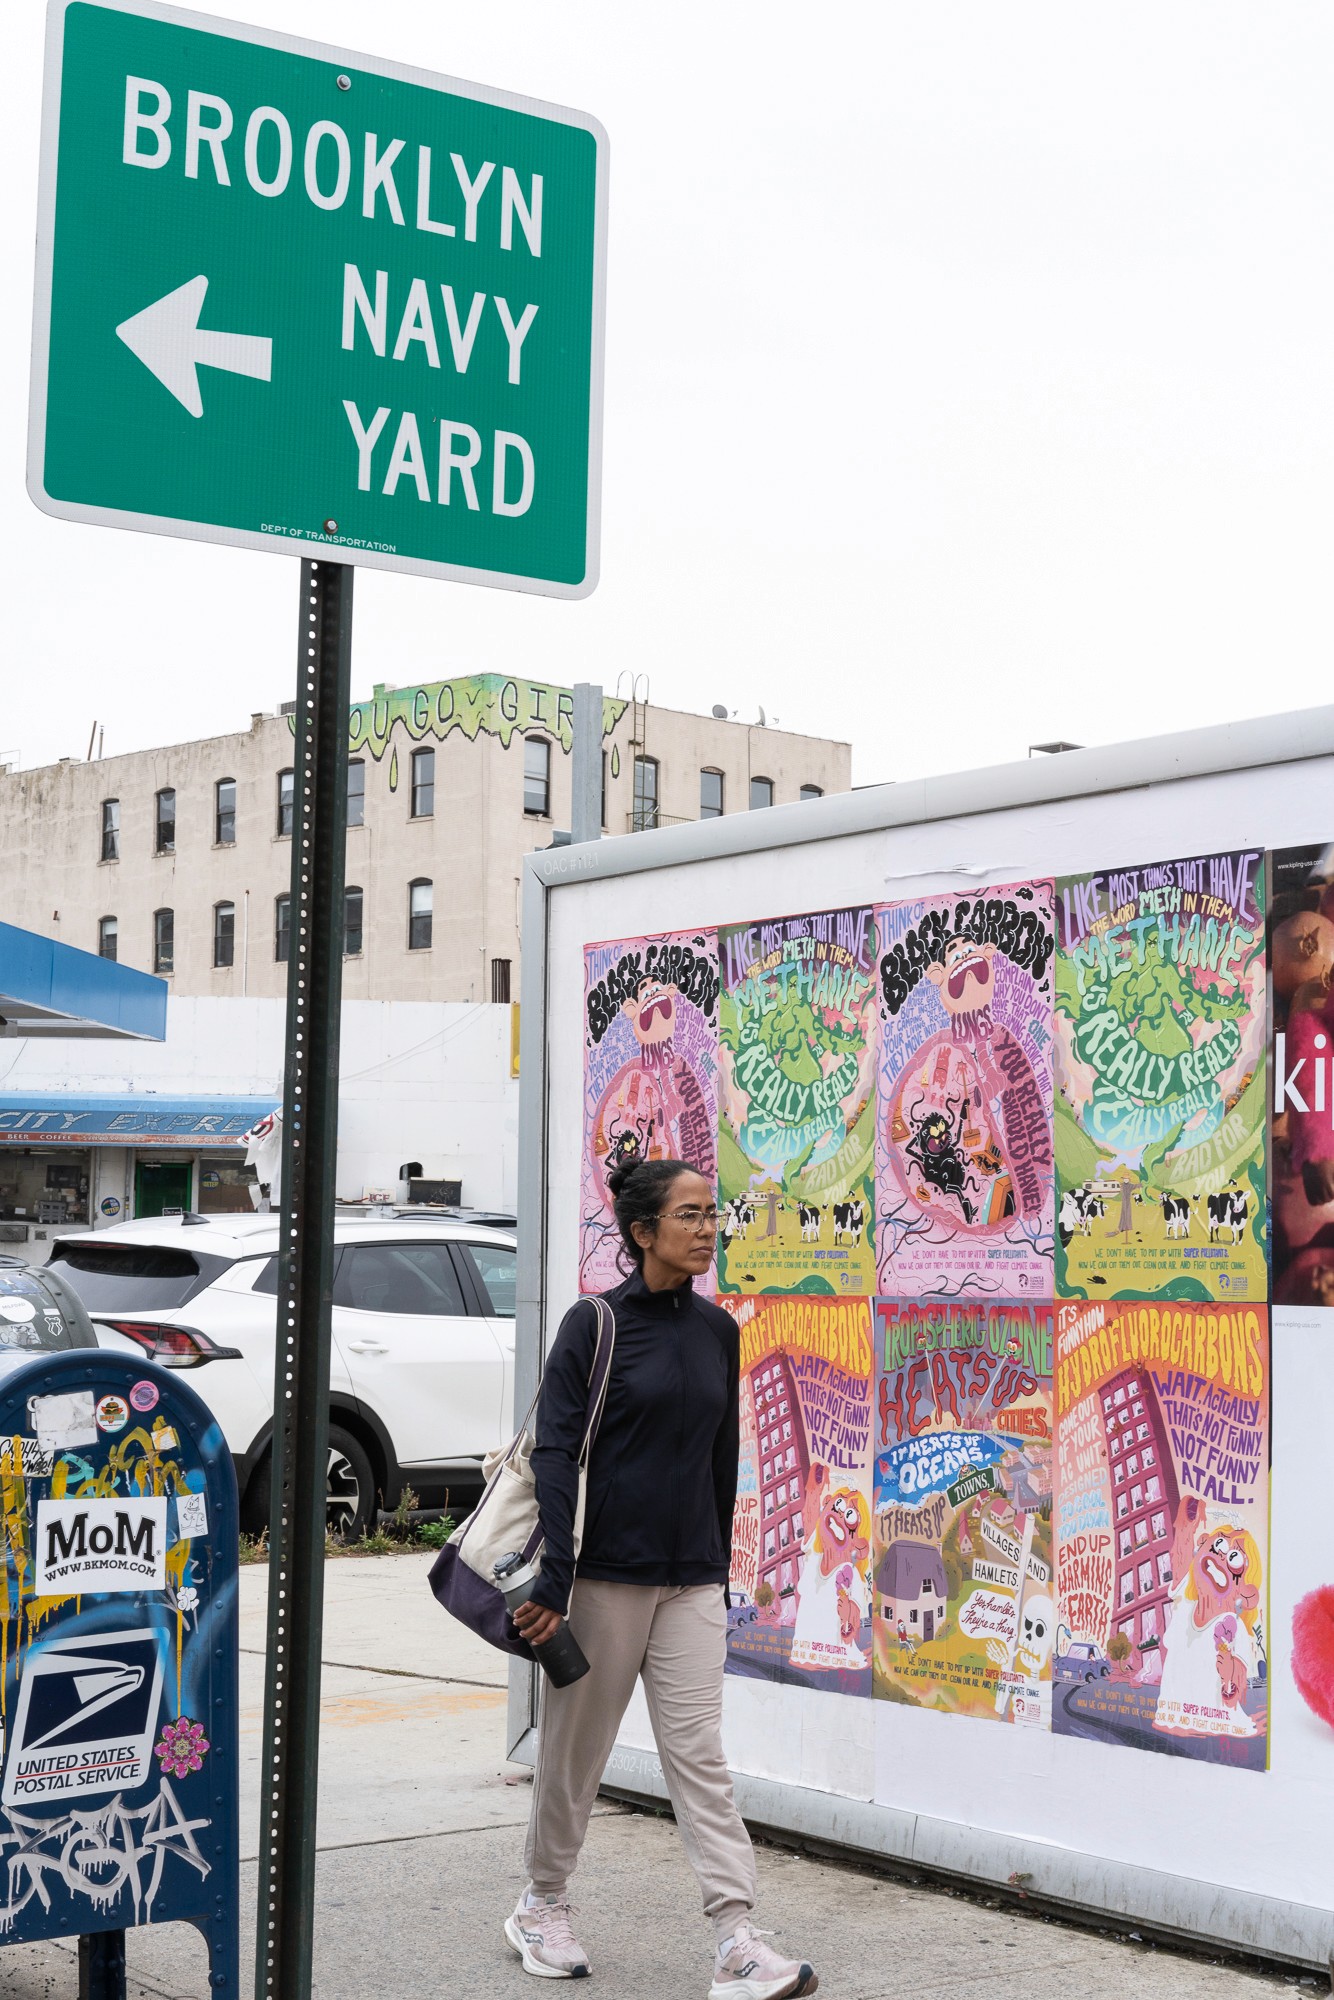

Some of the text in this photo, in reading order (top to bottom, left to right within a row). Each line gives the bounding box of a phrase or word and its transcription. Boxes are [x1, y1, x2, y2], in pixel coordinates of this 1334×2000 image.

[122, 74, 544, 258] BROOKLYN
[342, 262, 540, 385] NAVY
[342, 400, 536, 518] YARD
[261, 524, 396, 552] DEPT OF TRANSPORTATION
[349, 681, 574, 740] OU GO GIR
[1063, 853, 1259, 951] LIKE MOST THINGS THAT HAVE
[1090, 916, 1110, 935] THE
[1110, 903, 1136, 925] WORD
[1183, 893, 1196, 913] IN
[878, 902, 925, 949] THINK OF
[586, 949, 612, 985] THINK
[727, 909, 873, 992] LIKE MOST THINGS THAT HAVE
[762, 943, 827, 969] WORD IN
[880, 899, 1054, 1015] BLACK CARBON
[992, 954, 1008, 969] AND
[1072, 914, 1254, 996] METHANE
[587, 945, 720, 1043] BLACK CARBON
[734, 960, 868, 1031] METHANE
[993, 984, 1024, 1005] WHY YOU
[995, 966, 1035, 994] COMPLAIN
[884, 1015, 922, 1037] OF CAMPING
[884, 1020, 925, 1057] YOUR LIVING
[951, 1004, 994, 1044] LUNGS
[992, 999, 1051, 1051] HAVE THAT ONE
[641, 1037, 674, 1071] LUNGS
[700, 1052, 717, 1079] ONE
[882, 1031, 924, 1084] THEY MOVE
[1022, 1033, 1044, 1070] SERVICE
[1077, 1009, 1239, 1100] REALLY REALLY
[737, 1042, 810, 1122] REALLY
[1275, 1033, 1334, 1130] ki
[0, 1112, 264, 1132] CITY EXPRE
[1002, 1088, 1026, 1160] SHOULD
[1015, 1078, 1051, 1166] REALLY
[1094, 1078, 1221, 1146] REALLY REALLY
[804, 1134, 865, 1194] BAD FOR
[1170, 1113, 1249, 1182] BAD FOR
[369, 1193, 390, 1202] ICE
[1195, 1165, 1225, 1193] YOU
[988, 1249, 1001, 1258] SUPER
[877, 1303, 1053, 1378] TROPOSPHERIC OZONE
[1057, 1305, 1105, 1361] FUNNY HOW
[1058, 1305, 1077, 1332] IT'S
[1057, 1308, 1264, 1416] HYDROFLUOROCARBONS
[798, 1380, 828, 1408] THAT'S
[825, 1390, 845, 1419] NOT
[878, 1352, 1038, 1446] HEATS UP
[1058, 1392, 1096, 1442] COME OUT
[803, 1405, 869, 1452] NOT FUNNY
[1058, 1415, 1102, 1466] OF YOUR
[1162, 1400, 1203, 1432] THAT'S
[1202, 1411, 1227, 1444] NOT
[811, 1433, 866, 1469] AT ALL.
[891, 1433, 983, 1466] IT HEATS UP
[900, 1447, 992, 1494] OCEANS.
[1061, 1441, 1102, 1486] AC UNIT
[1171, 1428, 1260, 1485] NOT FUNNY
[1058, 1467, 1108, 1507] DESIGNED
[1182, 1461, 1254, 1505] AT ALL.
[741, 1497, 758, 1514] UP
[880, 1496, 946, 1541] IT HEATS UP
[45, 1510, 157, 1569] MoM
[982, 1522, 1021, 1562] VILLAGES
[1059, 1534, 1111, 1566] END UP
[44, 1560, 156, 1581] WWW.BKMOM.COM
[974, 1562, 1019, 1588] HAMLETS.
[1027, 1557, 1047, 1582] AND
[1058, 1555, 1112, 1600] WARMING
[1068, 1592, 1110, 1648] EARTH
[903, 1667, 909, 1675] WE
[950, 1674, 962, 1684] CLEAN
[982, 1680, 991, 1689] AND
[994, 1681, 1006, 1692] FIGHT
[1008, 1685, 1025, 1696] CLIMATE
[908, 1655, 916, 1666] WE
[934, 1660, 945, 1670] HAVE
[947, 1662, 953, 1672] TO
[955, 1664, 963, 1673] PUT
[964, 1666, 971, 1674] UP
[972, 1666, 984, 1676] WITH
[985, 1667, 1000, 1679] SUPER
[1183, 1703, 1198, 1715] SUPER
[17, 1746, 135, 1776] UNITED STATES
[14, 1774, 73, 1795] POSTAL
